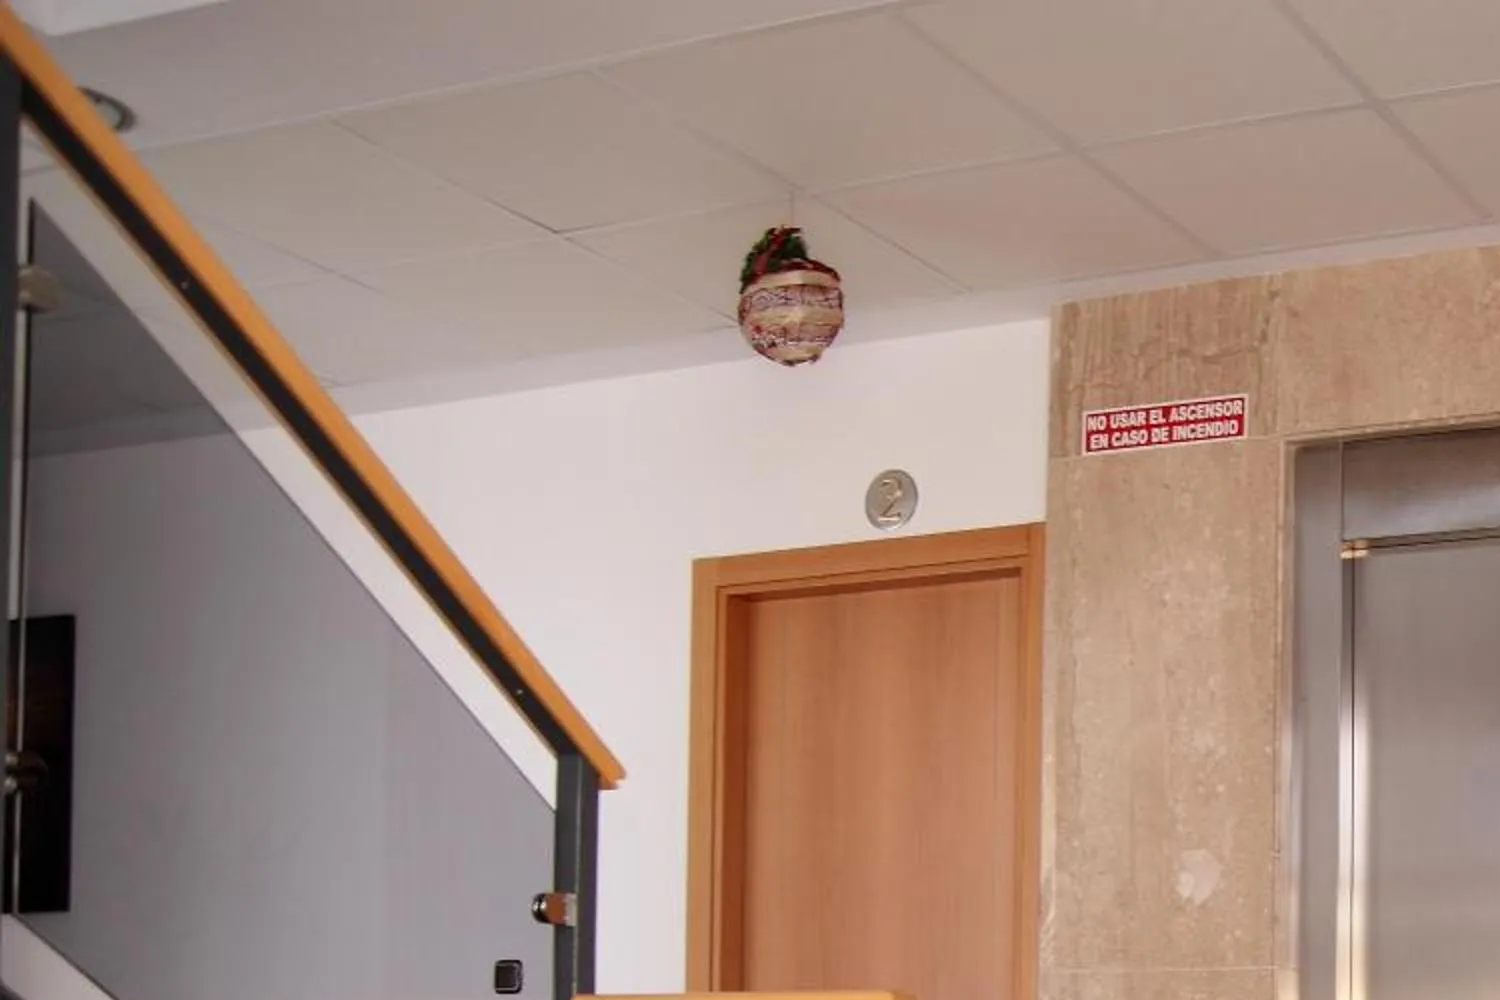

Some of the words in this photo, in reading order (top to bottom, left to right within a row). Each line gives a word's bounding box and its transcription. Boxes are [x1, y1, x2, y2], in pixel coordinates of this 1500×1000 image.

[1087, 416, 1107, 430] NO
[1110, 411, 1147, 428] USAR
[1150, 409, 1166, 424] EL
[1169, 400, 1243, 422] ASCENSOR
[1090, 433, 1108, 449] EN
[1112, 430, 1148, 447] CASO
[1151, 427, 1169, 442] DE
[1172, 420, 1239, 441] INCENDIO
[879, 476, 903, 521] 2
